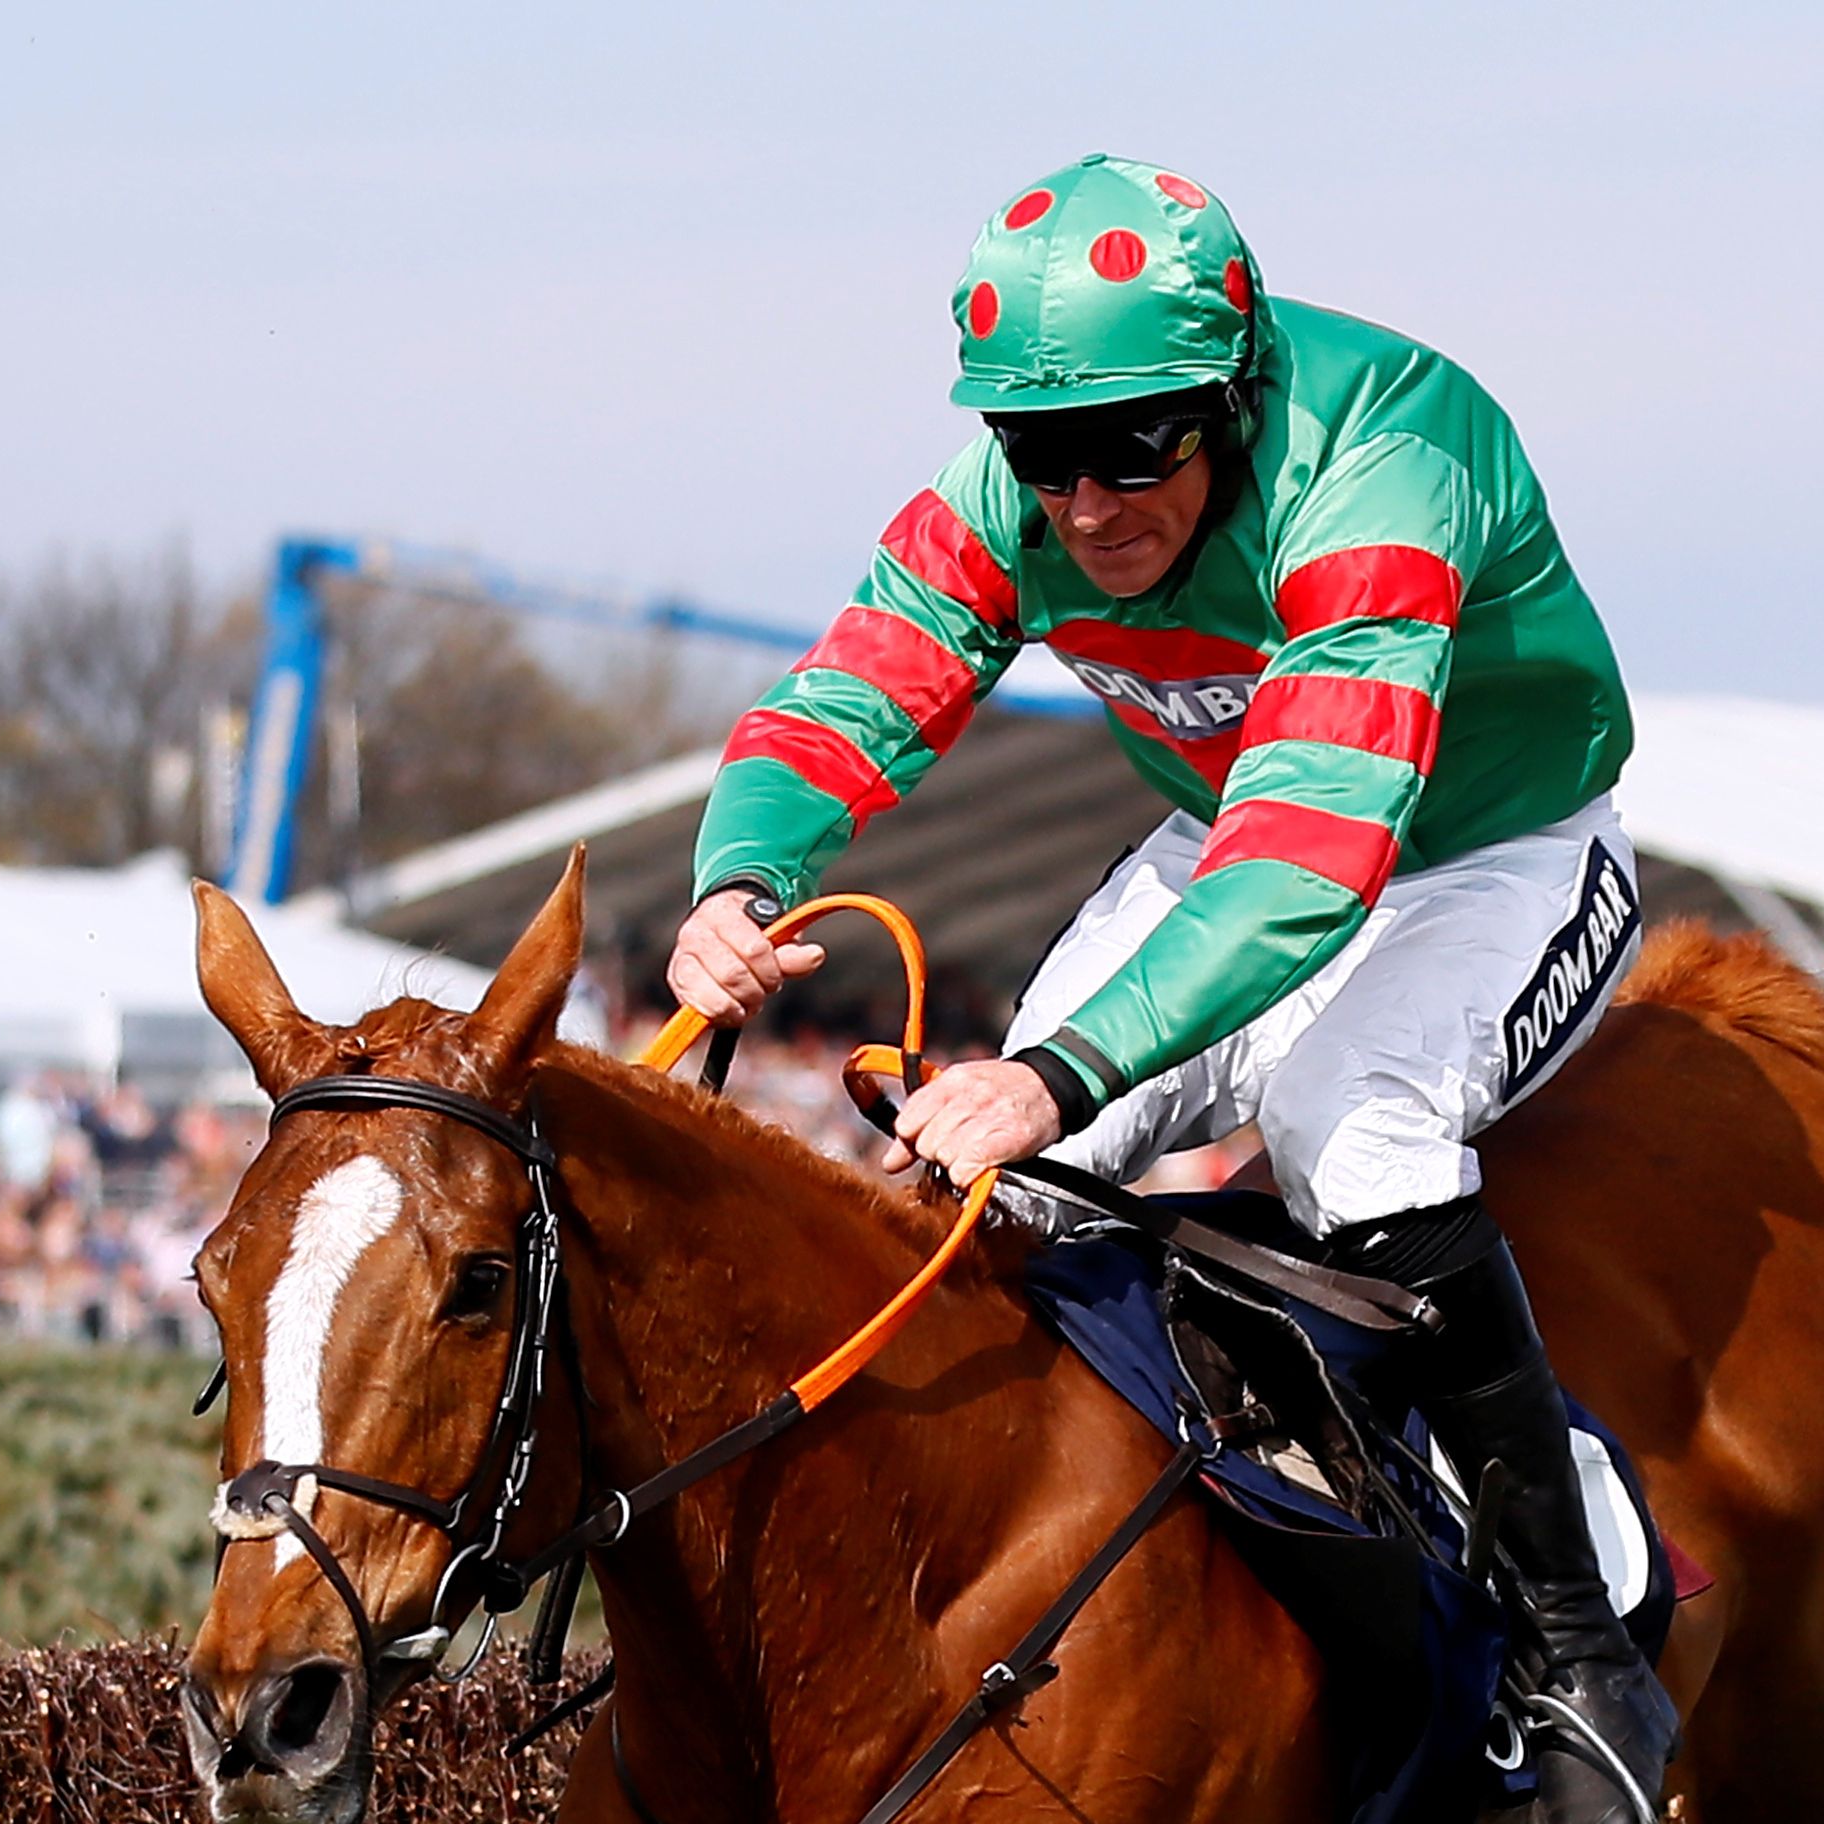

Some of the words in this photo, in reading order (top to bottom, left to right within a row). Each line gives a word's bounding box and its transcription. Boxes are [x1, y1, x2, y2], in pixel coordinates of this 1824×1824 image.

[1074, 661, 1202, 728] OOM
[1513, 930, 1593, 1079] DOOM
[1586, 863, 1632, 976] BAR
